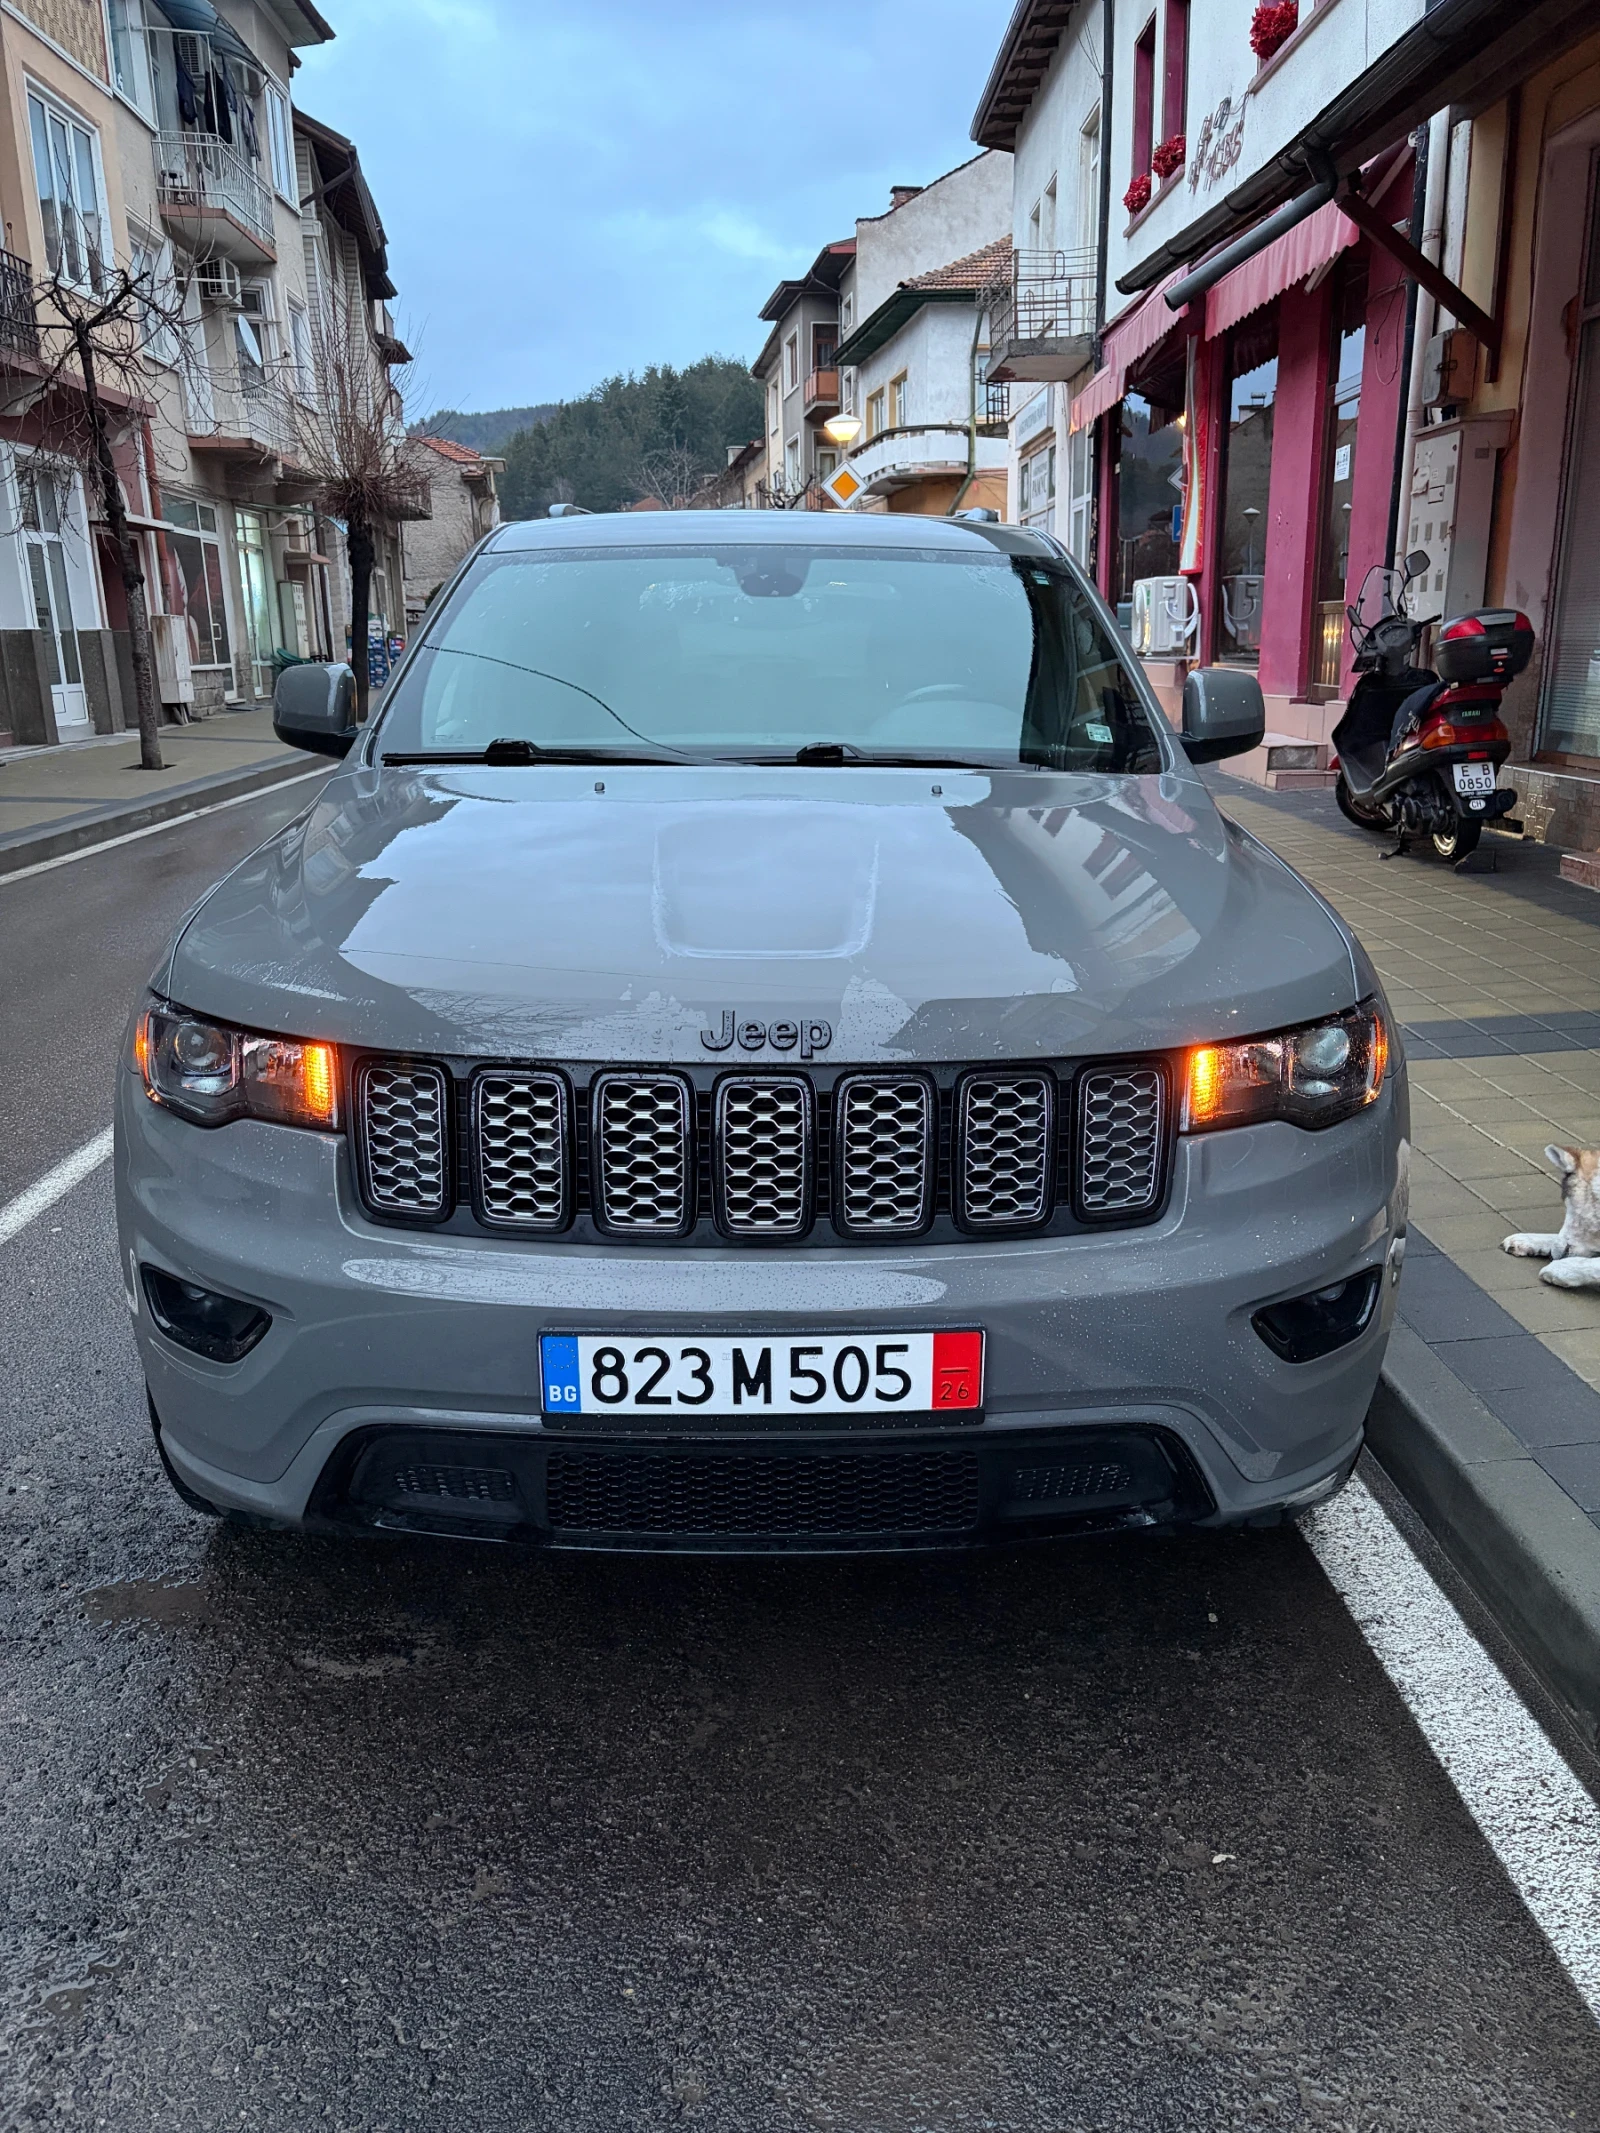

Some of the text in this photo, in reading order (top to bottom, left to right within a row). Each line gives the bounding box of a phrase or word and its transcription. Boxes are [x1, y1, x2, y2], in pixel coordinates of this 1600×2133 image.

[1461, 764, 1490, 777] E B
[1459, 777, 1492, 790] 0850
[1471, 801, 1482, 809] CH
[701, 1010, 832, 1060] Jeep
[591, 1344, 912, 1405] 823 M 505
[549, 1385, 577, 1402] BG
[940, 1382, 969, 1400] 26
